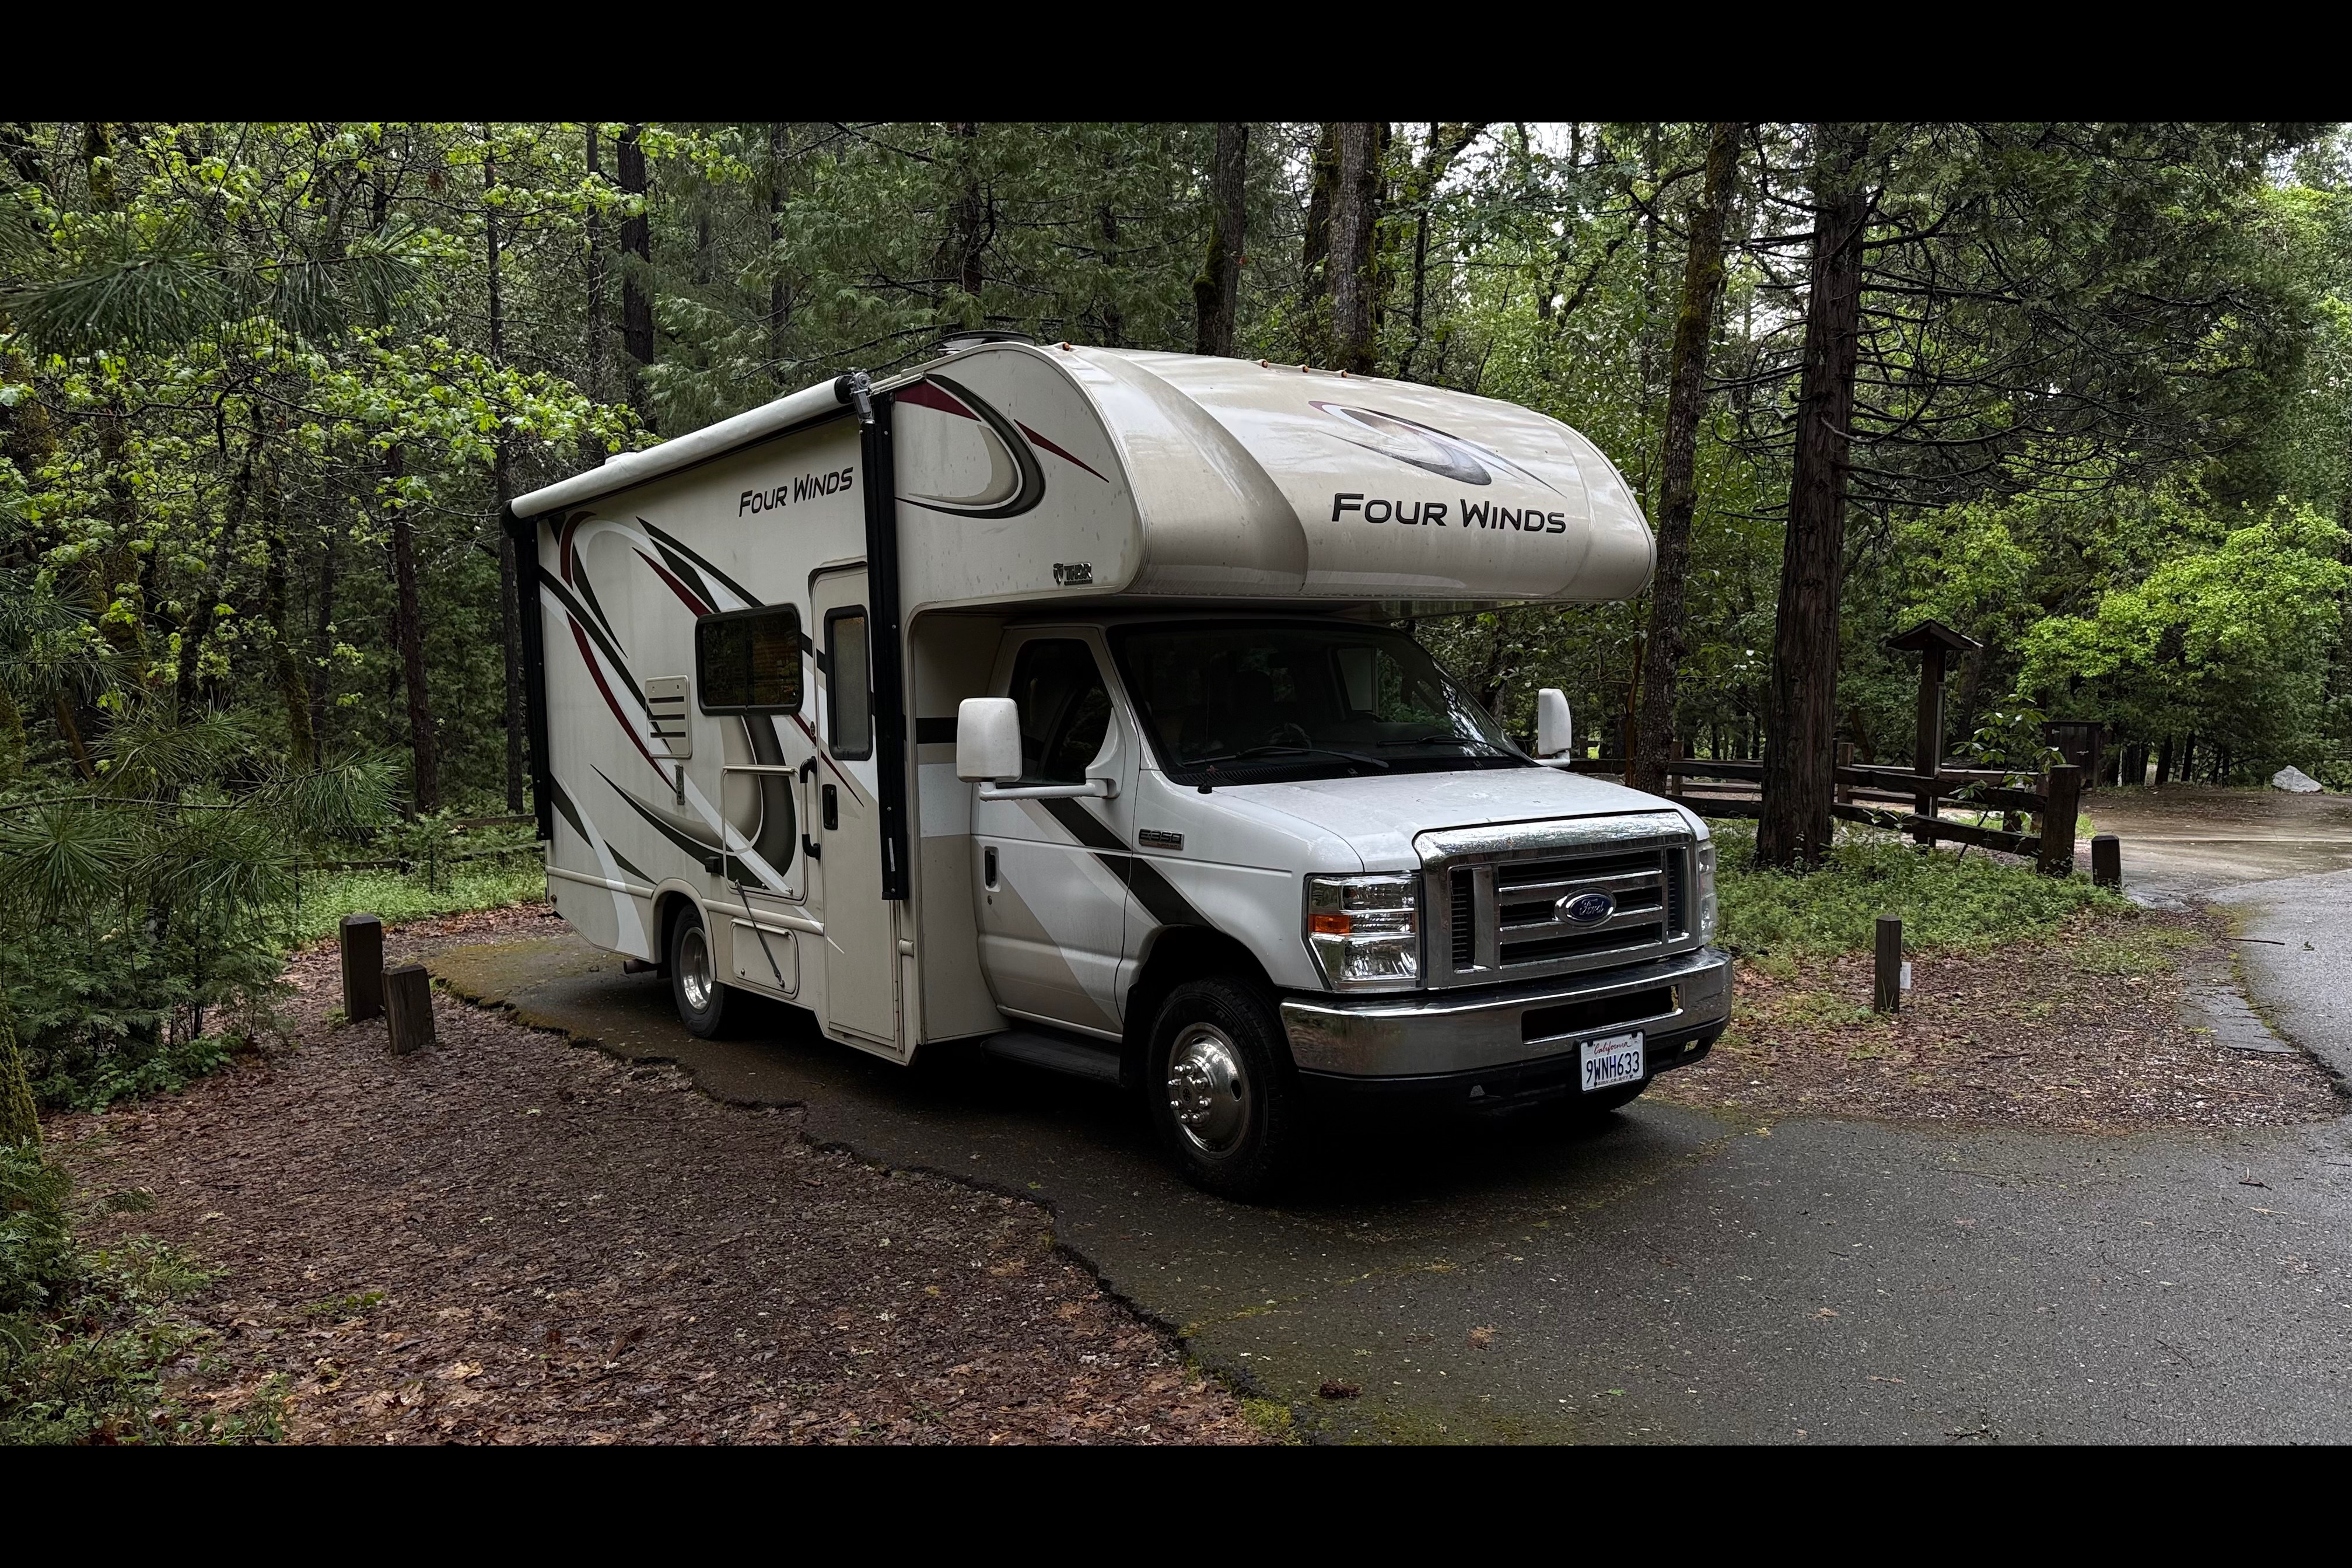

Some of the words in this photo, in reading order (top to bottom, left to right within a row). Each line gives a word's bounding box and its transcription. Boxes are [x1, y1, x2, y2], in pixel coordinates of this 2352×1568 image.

[738, 485, 788, 517] FOUR
[794, 467, 853, 503] WINDS
[1331, 492, 1448, 527] FOUR
[1460, 499, 1566, 534] WINDS
[1579, 898, 1604, 915] Ford
[1594, 1041, 1632, 1055] California
[1586, 1051, 1639, 1083] 9WNH633
